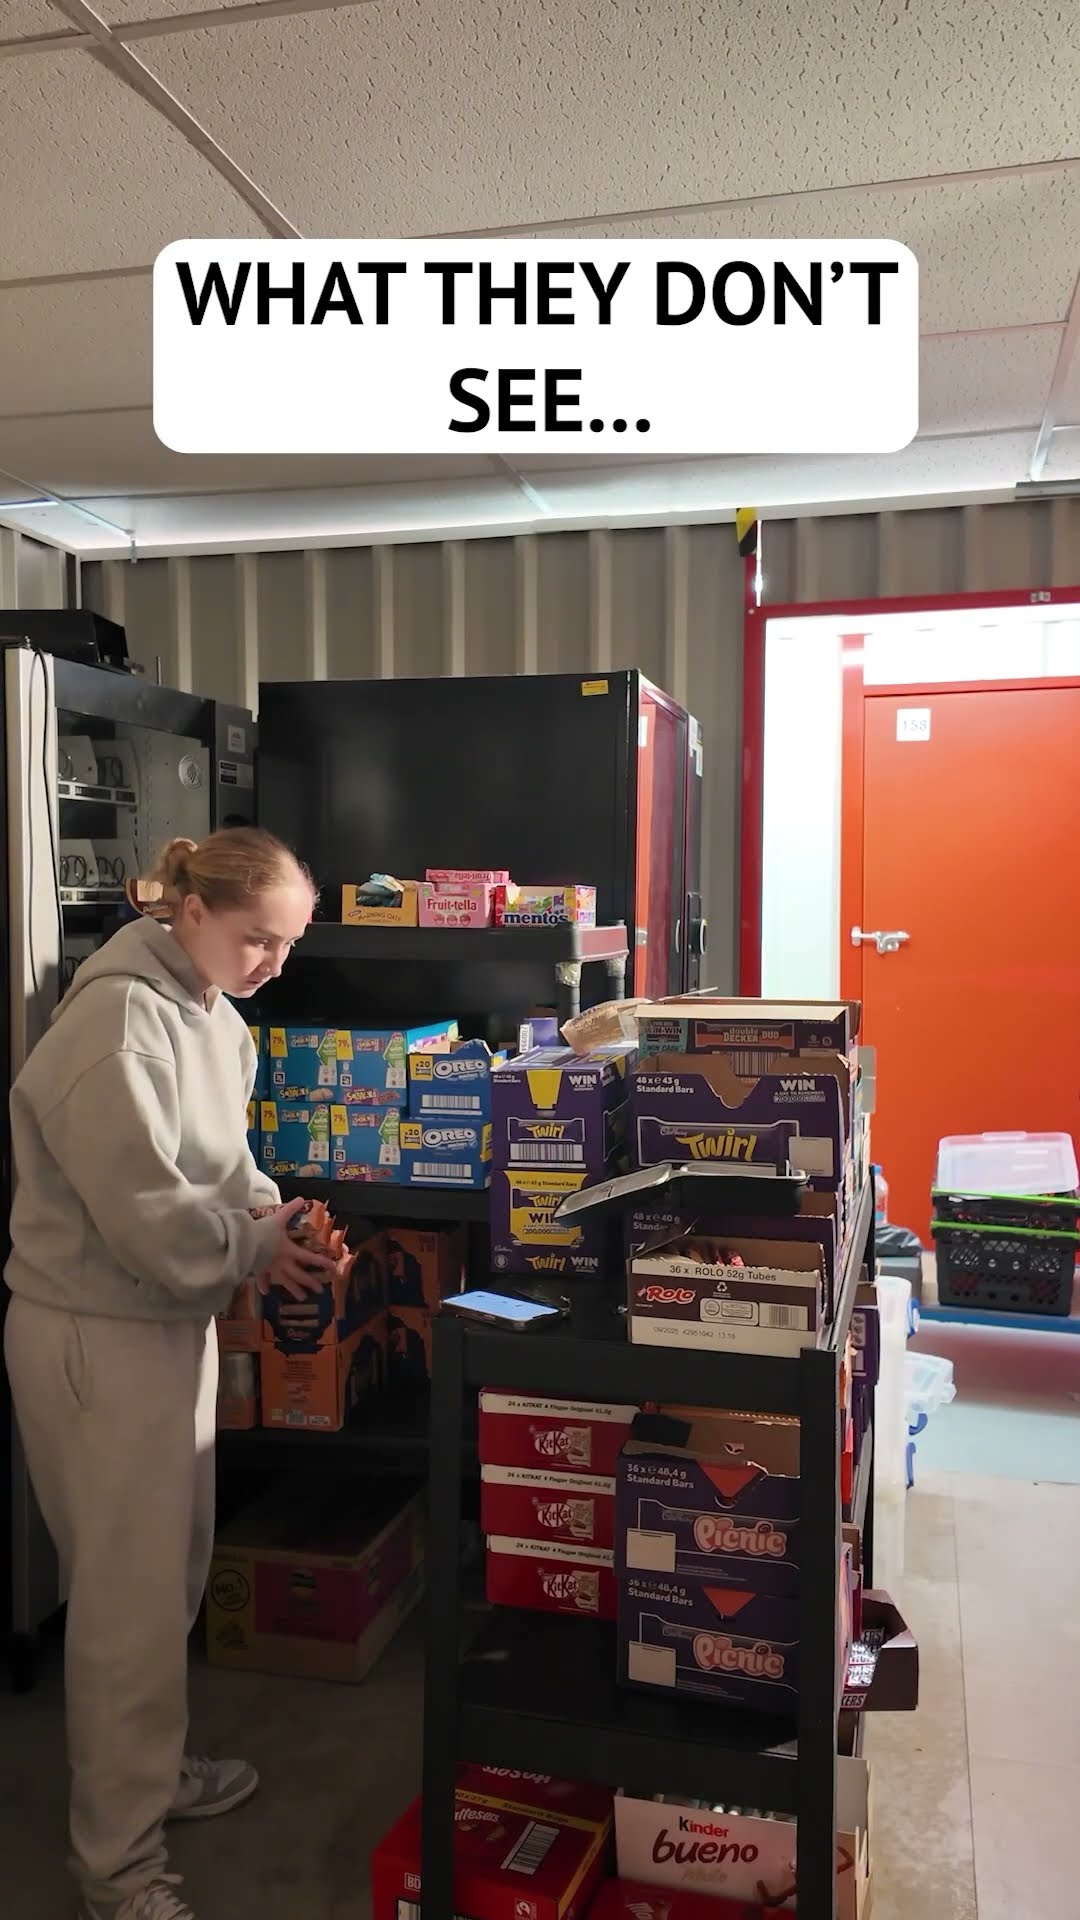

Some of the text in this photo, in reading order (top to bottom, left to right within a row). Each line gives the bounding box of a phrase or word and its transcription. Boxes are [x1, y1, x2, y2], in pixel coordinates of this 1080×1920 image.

[903, 719, 927, 732] 158
[504, 911, 569, 926] mentos
[722, 1030, 780, 1043] DECKER DUO
[729, 1027, 759, 1035] double
[434, 1060, 487, 1079] OREO
[568, 1074, 597, 1085] WIN
[636, 1076, 647, 1085] 48
[662, 1077, 673, 1086] 43
[674, 1078, 680, 1087] g
[780, 1079, 816, 1091] WIN
[636, 1084, 694, 1094] Standard Bars
[423, 1128, 477, 1148] OREO
[525, 1122, 565, 1139] Twirl
[675, 1128, 758, 1162] Twirl
[525, 1252, 599, 1272] Twirl WIN
[669, 1264, 682, 1274] 36
[695, 1267, 724, 1277] ROLO
[726, 1268, 744, 1280] 52g
[749, 1270, 777, 1282] Tubes
[539, 1431, 569, 1454] KitKat
[626, 1464, 639, 1472] 36
[657, 1467, 679, 1477] 48,4
[680, 1470, 686, 1479] g
[626, 1474, 694, 1489] Standard Bars
[542, 1503, 572, 1526] KitKat
[694, 1515, 788, 1557] Picnic
[548, 1575, 578, 1598] KitKat
[680, 1588, 686, 1596] g
[628, 1587, 693, 1607] Standard Bars
[692, 1633, 786, 1680] Picnic
[679, 1816, 729, 1838] kinder
[652, 1830, 758, 1864] bueno
